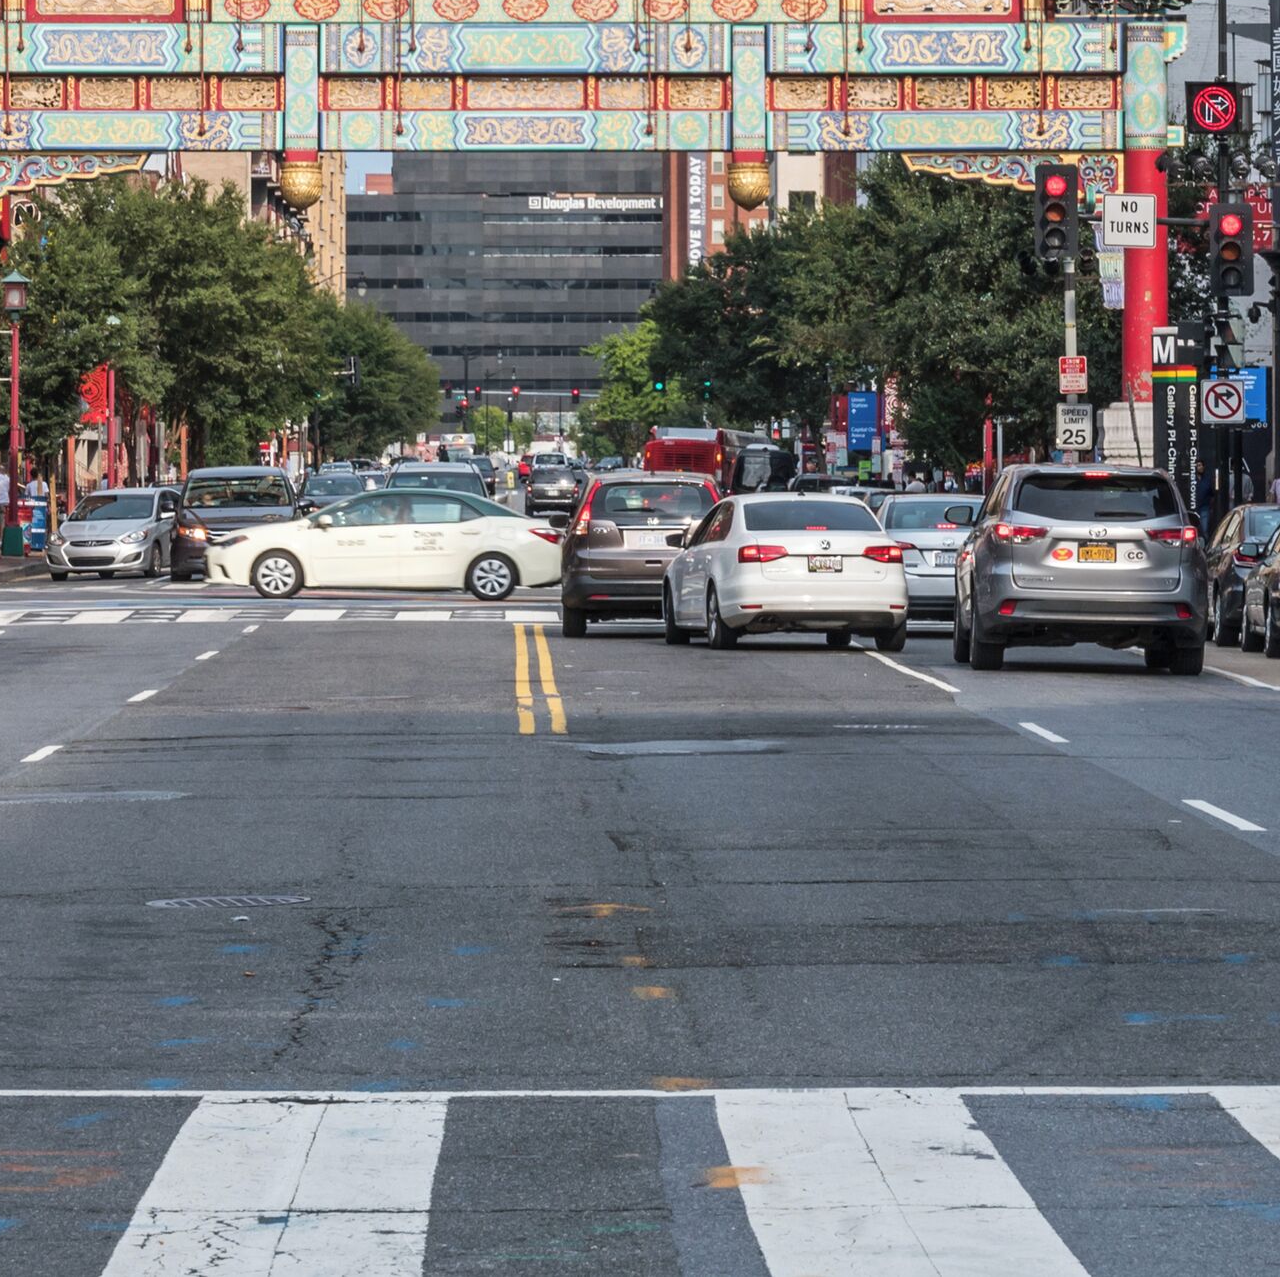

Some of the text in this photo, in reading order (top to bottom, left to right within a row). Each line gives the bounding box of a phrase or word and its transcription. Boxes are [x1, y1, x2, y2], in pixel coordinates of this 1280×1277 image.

[689, 156, 702, 205] TODAY
[543, 196, 586, 212] Douglas
[587, 196, 657, 212] Development
[1121, 201, 1138, 213] NO
[689, 211, 702, 226] IN
[1110, 220, 1149, 234] TURNS
[1153, 336, 1175, 364] M
[1061, 408, 1089, 417] SPEED
[1167, 385, 1176, 427] Gallery
[1189, 384, 1197, 427] Gallery
[1063, 417, 1085, 425] LIMIT
[1062, 429, 1086, 445] 25
[1127, 551, 1144, 560] CC
